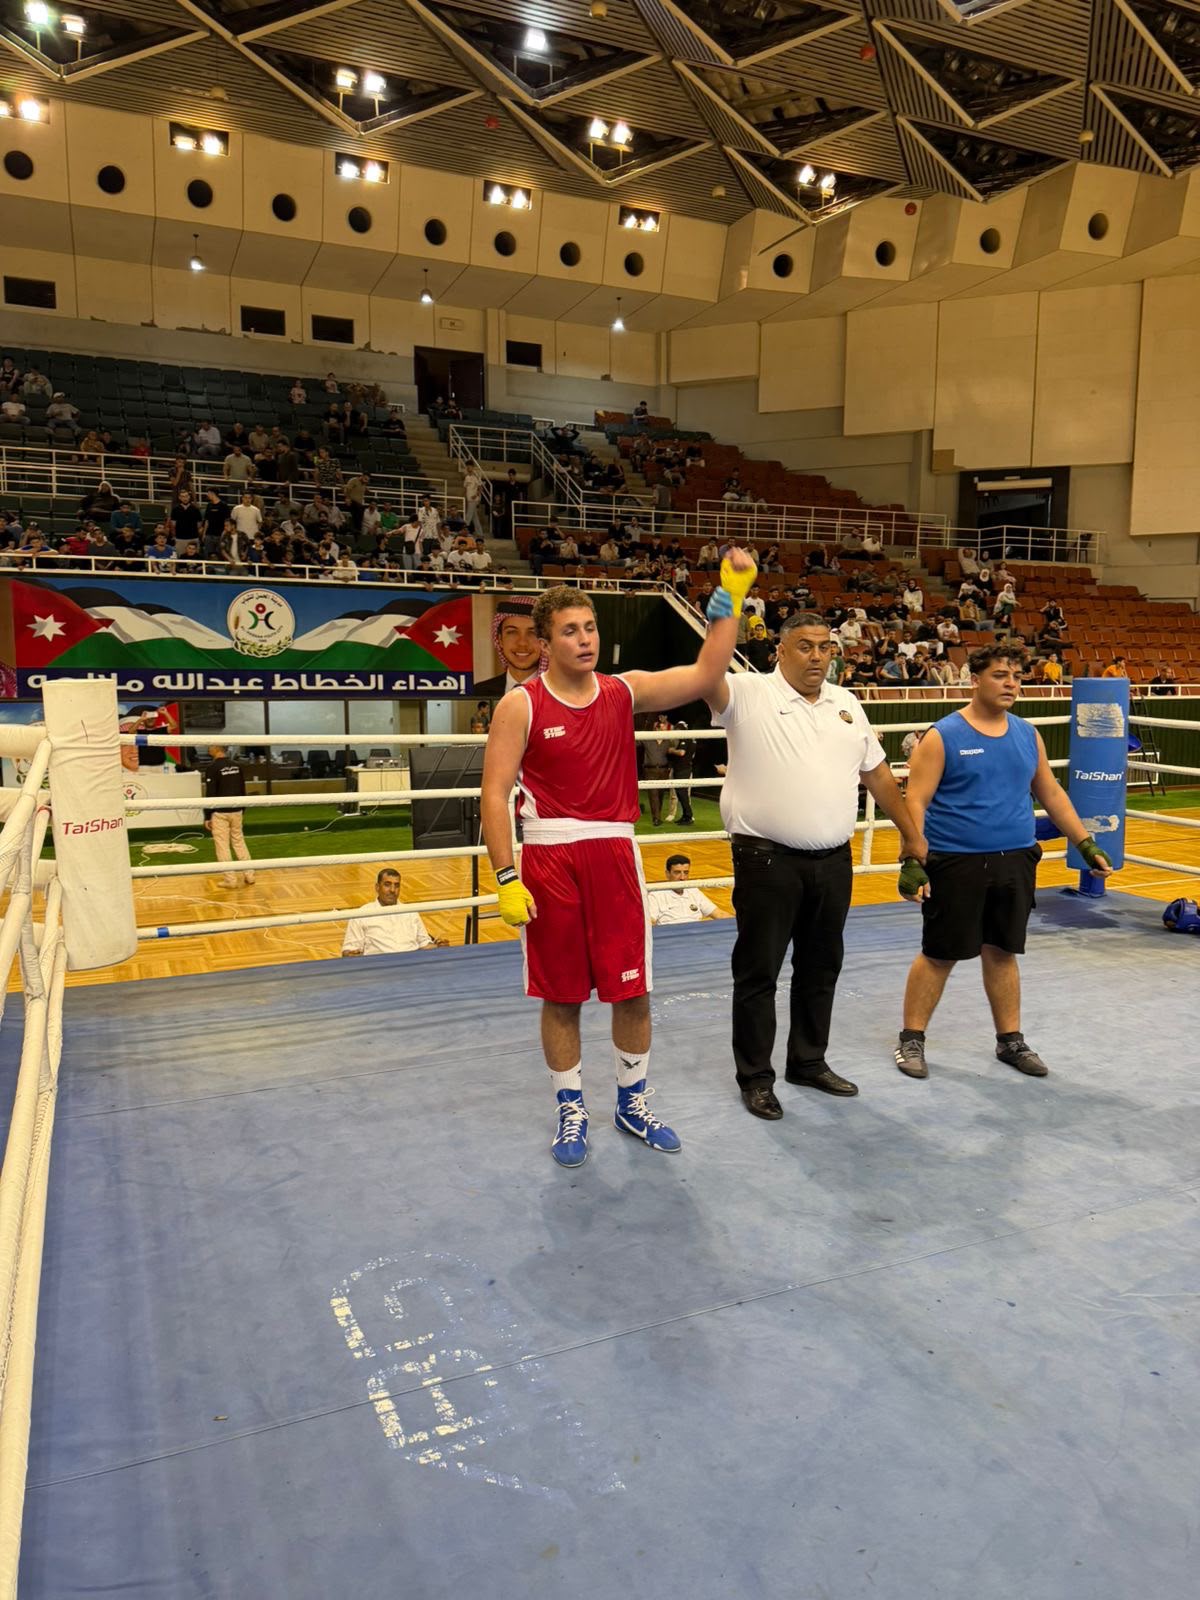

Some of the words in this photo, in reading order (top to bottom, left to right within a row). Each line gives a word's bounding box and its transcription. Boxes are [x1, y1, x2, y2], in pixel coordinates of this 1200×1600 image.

[153, 673, 265, 694] عبدالله
[271, 672, 385, 690] الخطاط
[391, 674, 467, 695] إهداء
[1074, 769, 1123, 781] TaiShan
[62, 817, 124, 835] TaiShan
